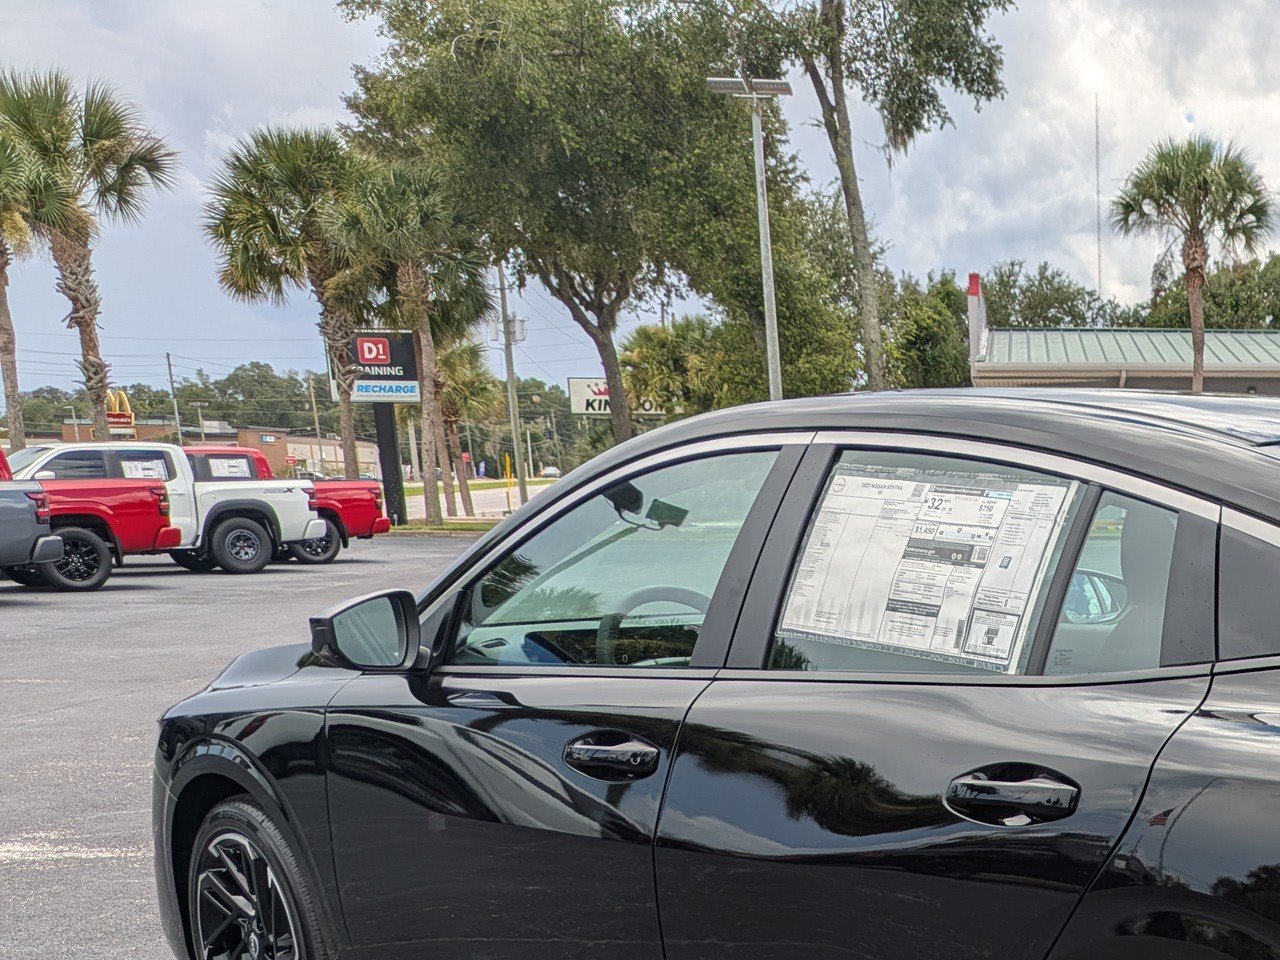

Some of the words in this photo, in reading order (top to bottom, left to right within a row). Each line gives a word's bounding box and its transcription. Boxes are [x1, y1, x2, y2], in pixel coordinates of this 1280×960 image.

[363, 342, 386, 359] D1
[356, 385, 417, 393] RECHARGE
[927, 497, 944, 510] 32
